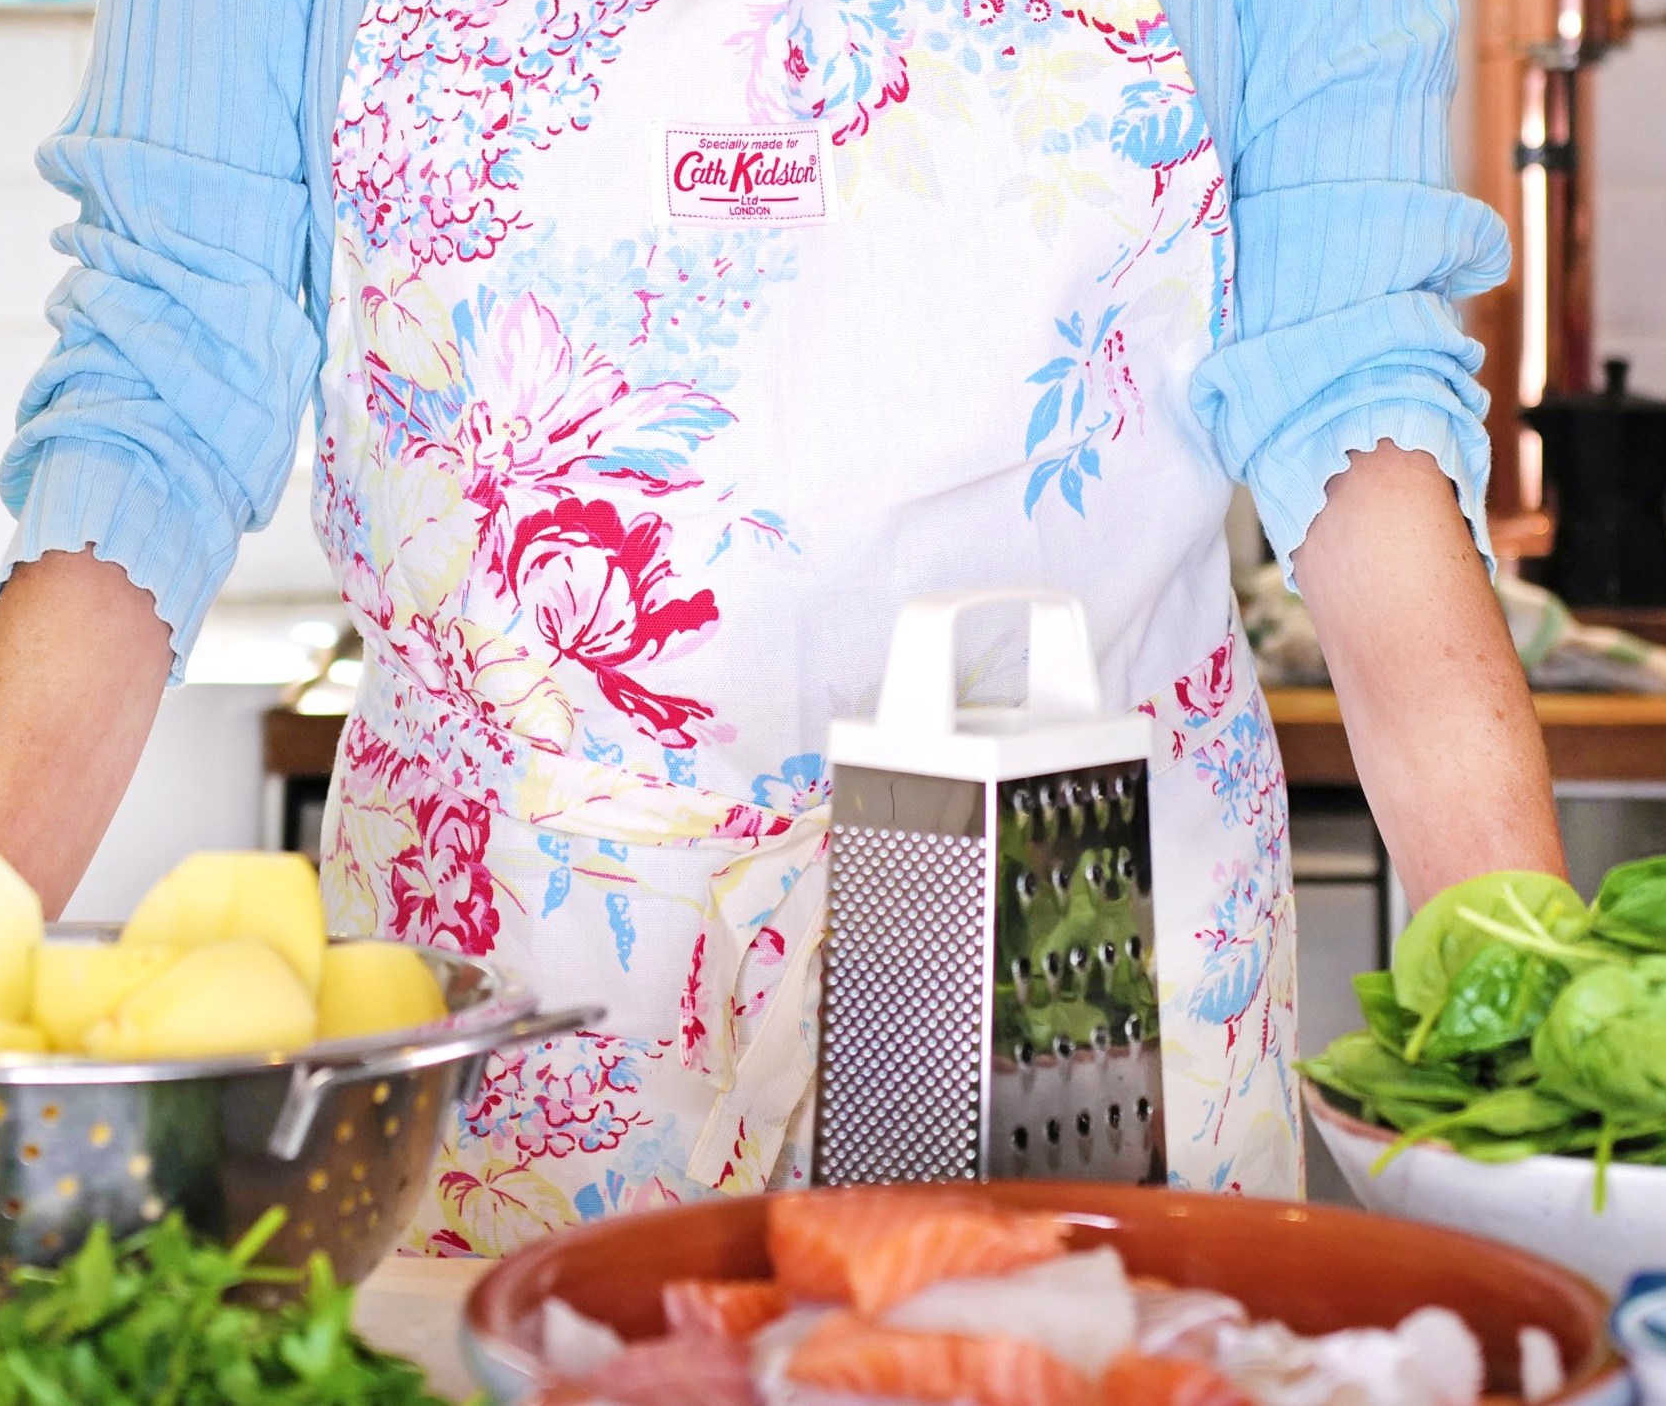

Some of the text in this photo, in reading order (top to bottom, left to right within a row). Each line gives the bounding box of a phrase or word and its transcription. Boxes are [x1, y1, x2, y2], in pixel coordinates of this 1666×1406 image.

[698, 138, 799, 151] Specially made for
[674, 151, 817, 194] Cath Kidston
[741, 195, 759, 205] Ltd
[729, 206, 771, 216] LONDON
